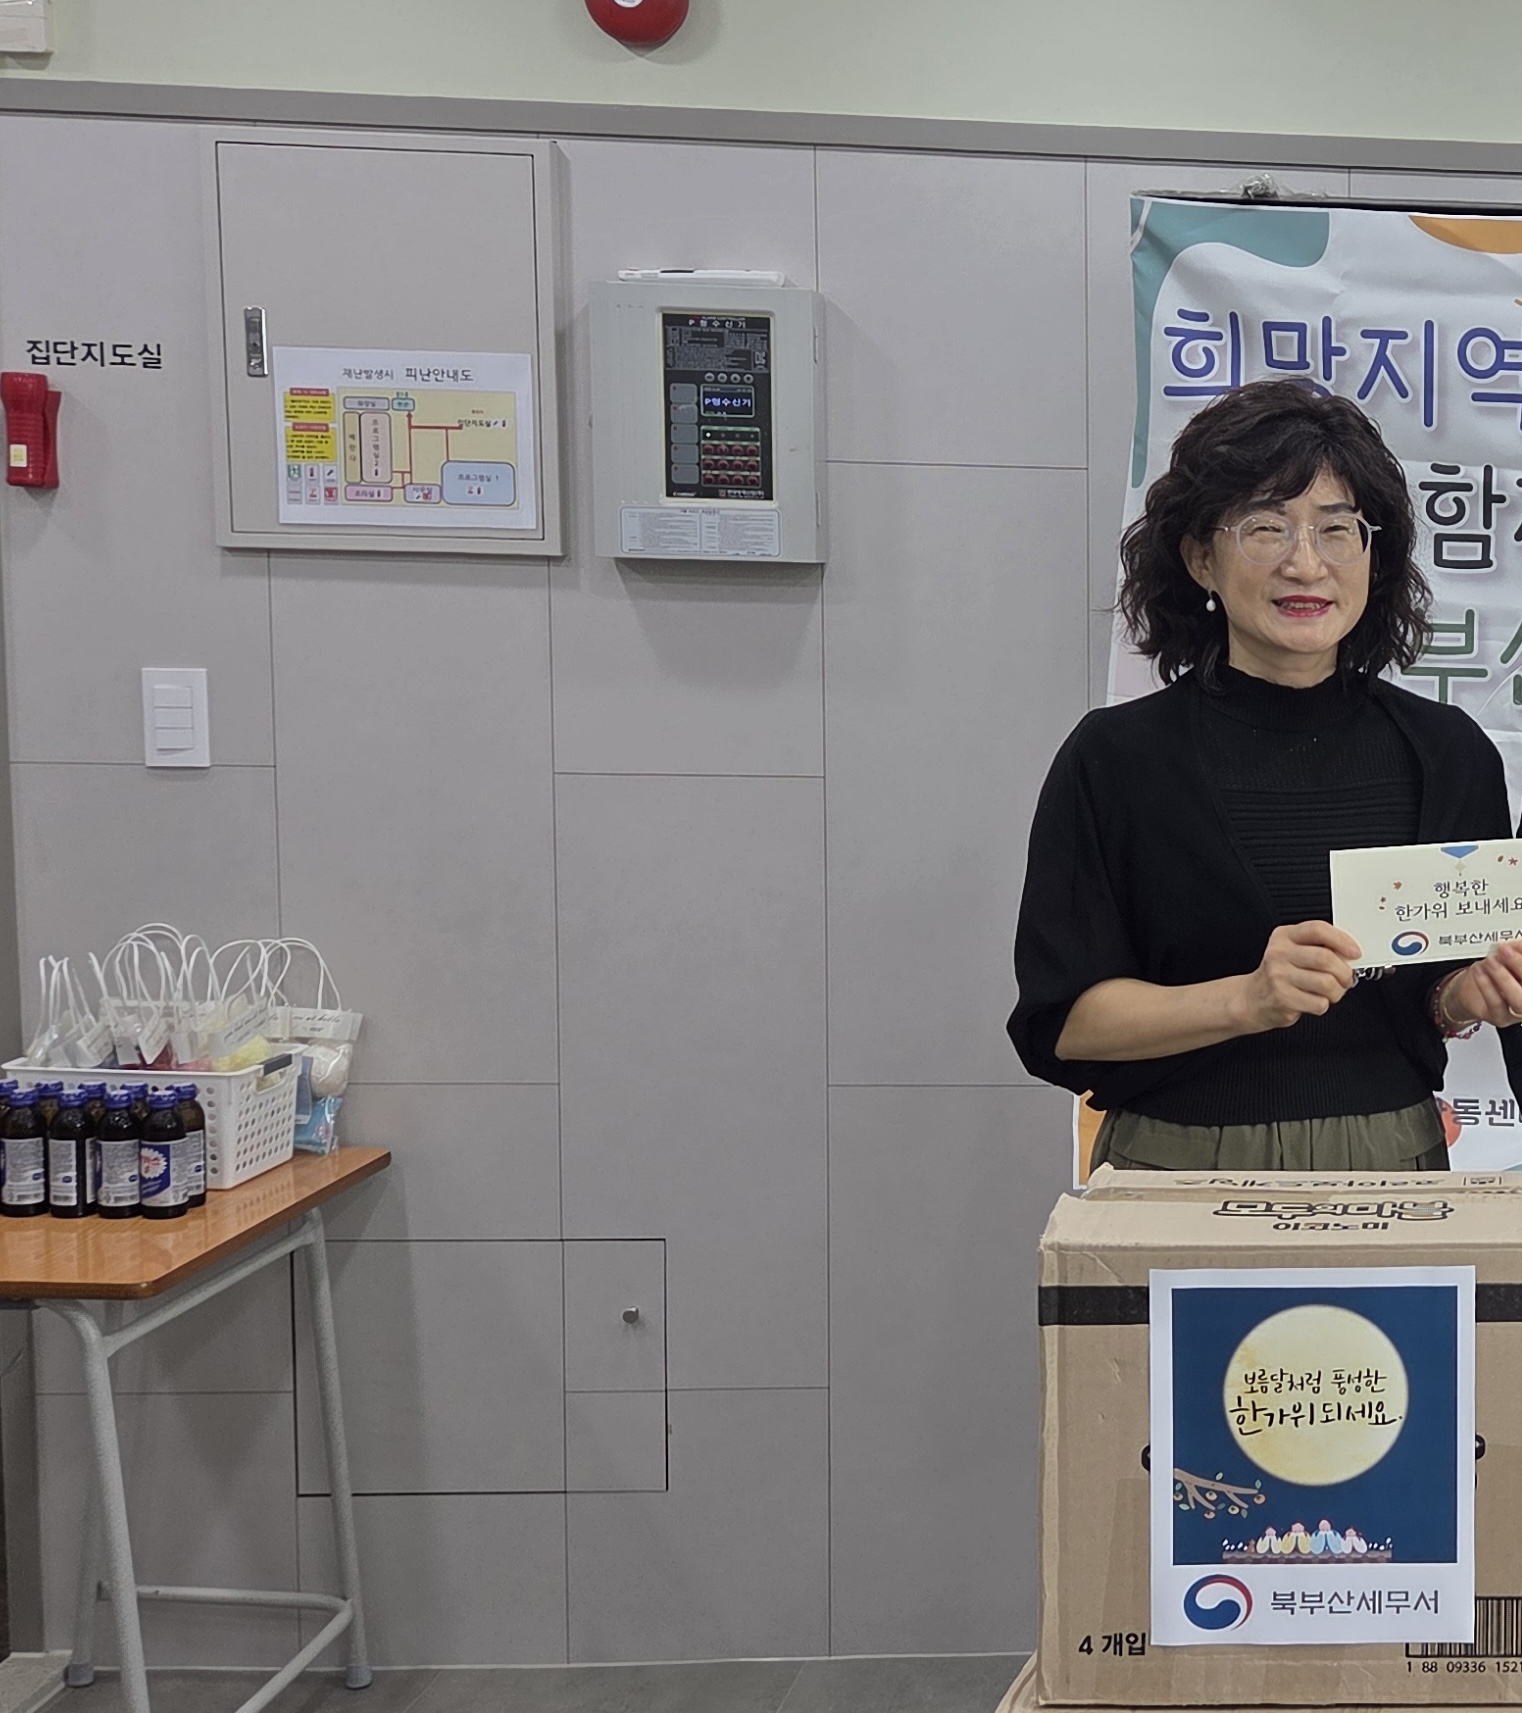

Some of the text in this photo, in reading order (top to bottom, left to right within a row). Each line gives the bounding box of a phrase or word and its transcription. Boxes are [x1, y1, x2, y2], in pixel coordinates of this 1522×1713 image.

[26, 340, 162, 369] 집단지도실
[342, 368, 474, 382] 재난발생시 피난안내도
[1433, 879, 1489, 898] 행복한
[1395, 902, 1448, 922] 한가위
[1244, 1368, 1388, 1395] 보름달처럼 풍성한
[1270, 1589, 1440, 1615] 북부산세무서
[1078, 1632, 1147, 1657] 4 개입
[1406, 1661, 1412, 1673] 1
[1421, 1661, 1438, 1673] 88
[1446, 1661, 1486, 1673] 09336
